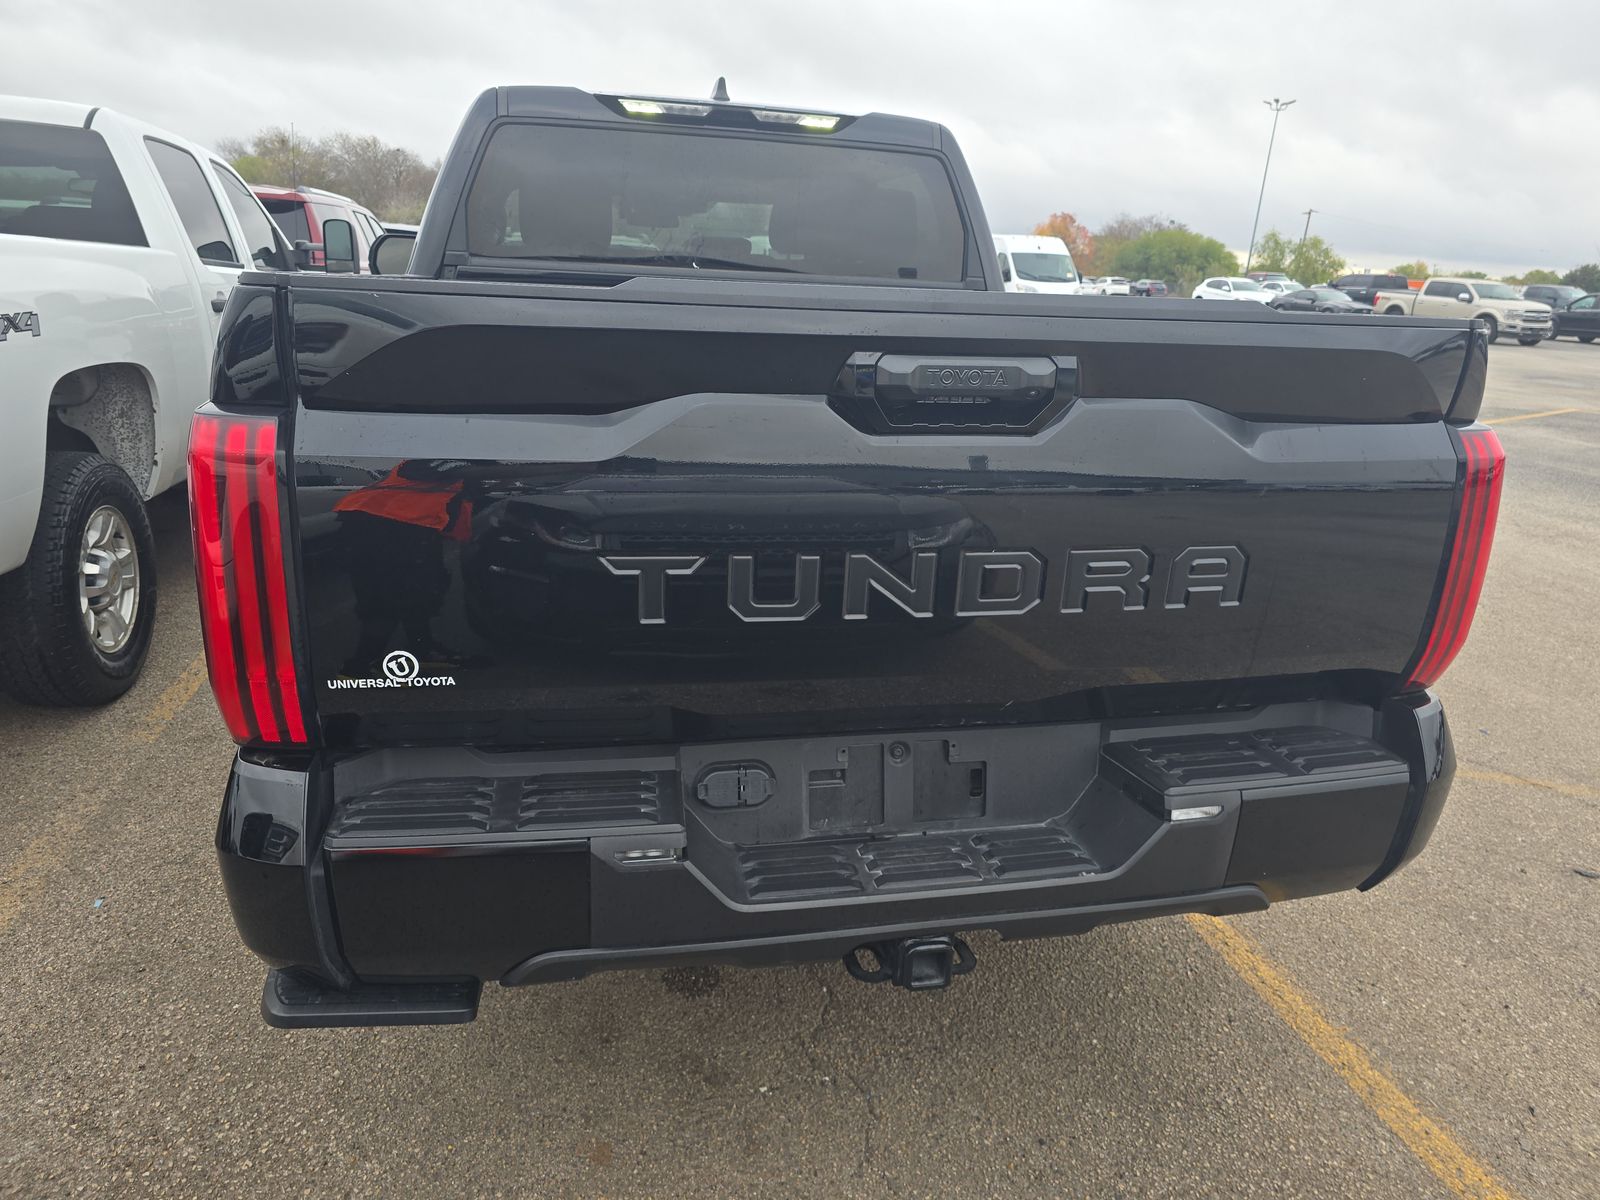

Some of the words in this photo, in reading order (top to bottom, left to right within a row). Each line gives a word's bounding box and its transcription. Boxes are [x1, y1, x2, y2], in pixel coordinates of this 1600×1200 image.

[926, 368, 1009, 387] TOYOTA
[598, 545, 1248, 624] TUNDRA
[327, 678, 402, 689] UNIVERSAL
[407, 676, 456, 687] TOYOTA
